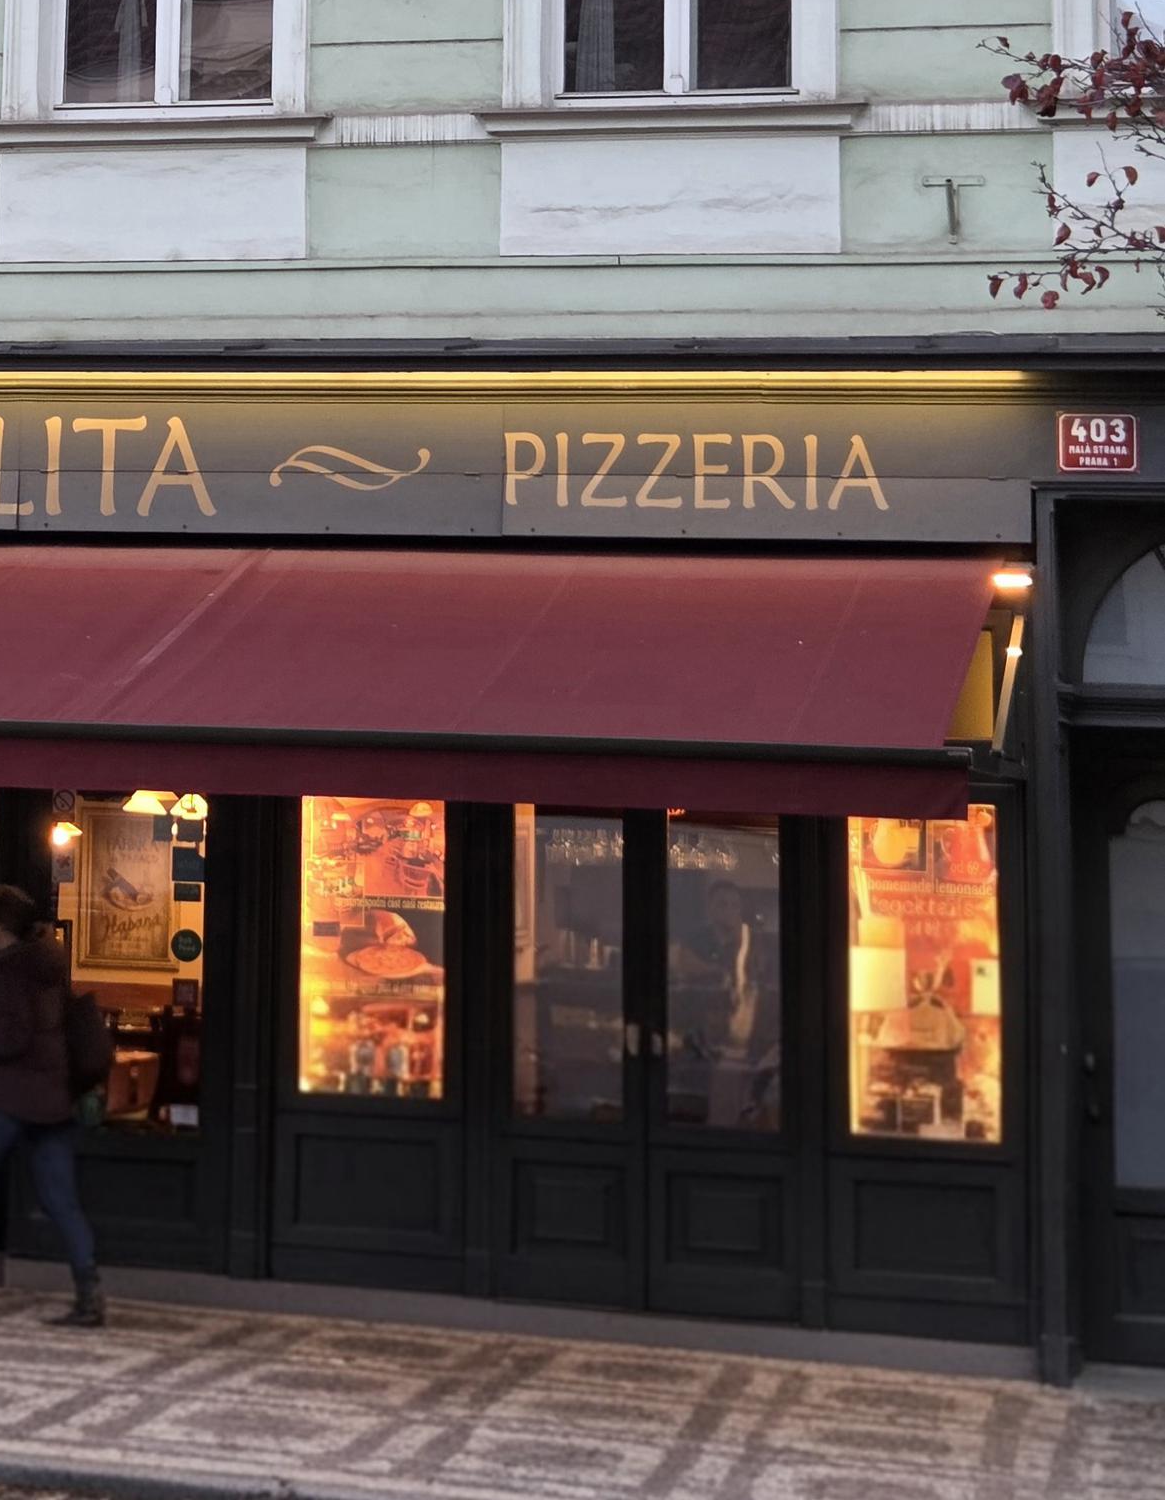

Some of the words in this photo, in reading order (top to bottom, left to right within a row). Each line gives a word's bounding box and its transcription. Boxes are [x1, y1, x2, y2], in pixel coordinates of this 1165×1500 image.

[1071, 418, 1126, 442] 403
[1093, 446, 1127, 455] STRANA
[1079, 457, 1108, 466] PRAHA
[503, 431, 889, 511] PIZZERIA
[935, 878, 993, 896] lemonade
